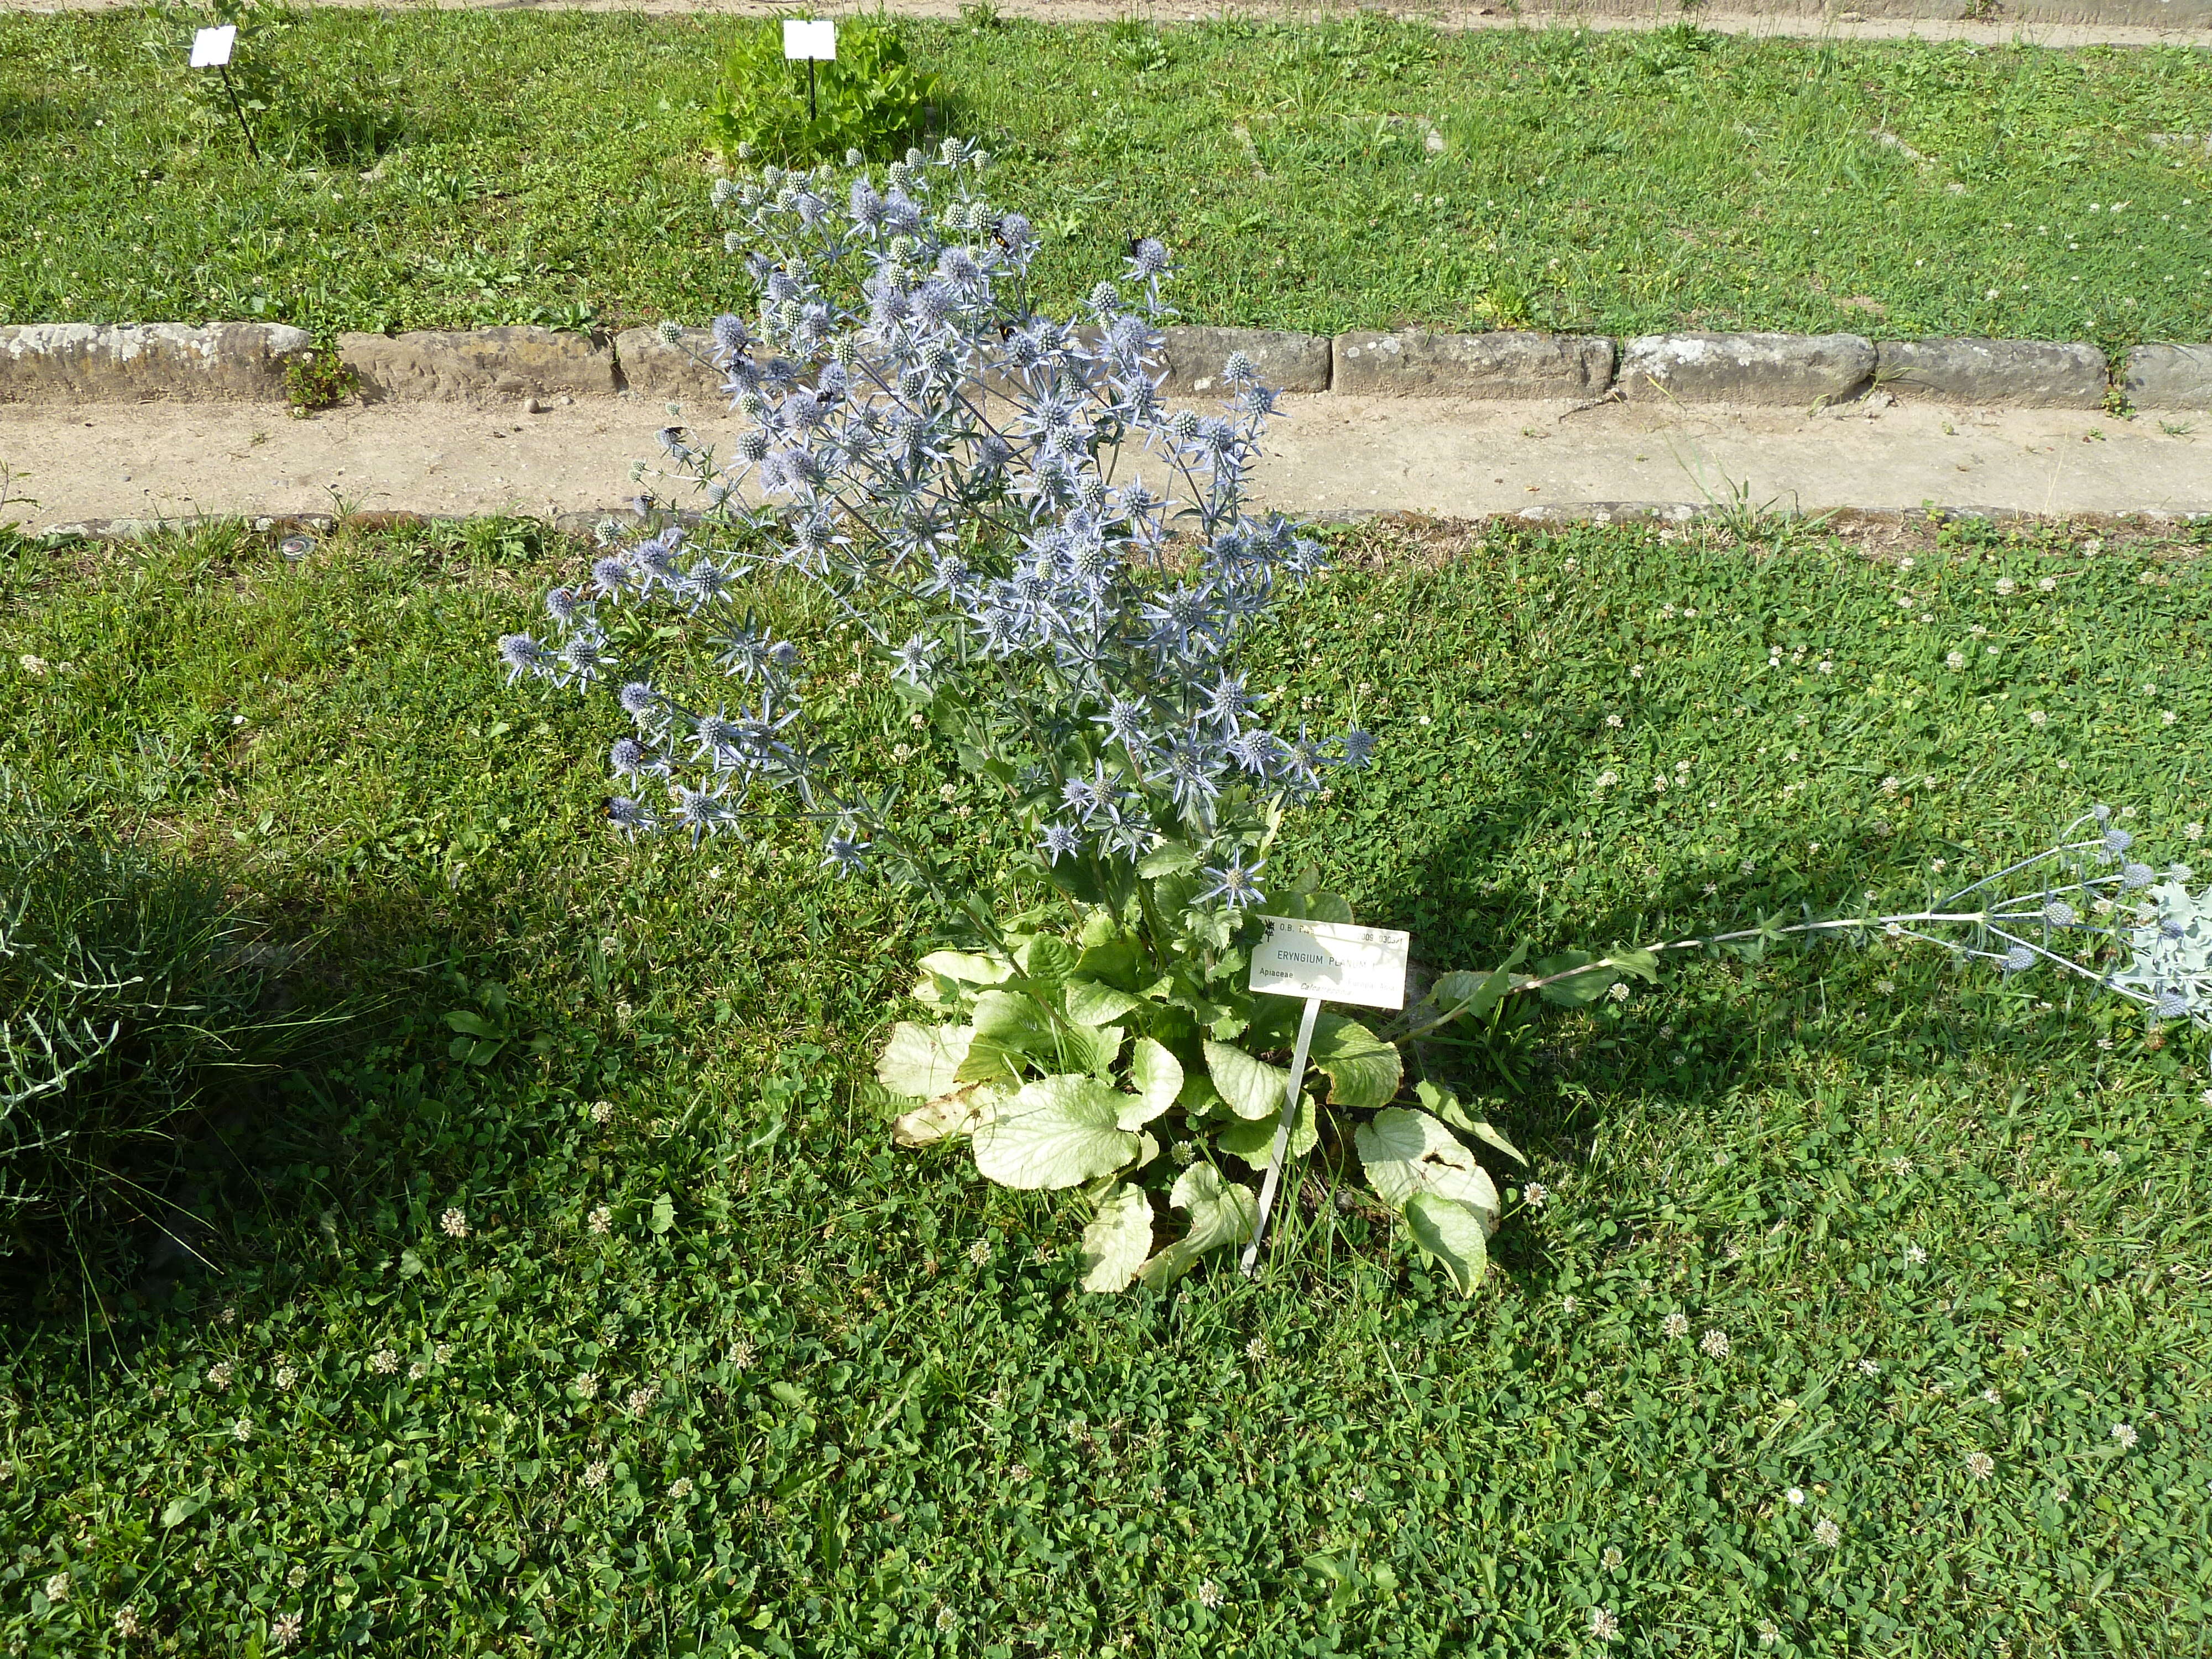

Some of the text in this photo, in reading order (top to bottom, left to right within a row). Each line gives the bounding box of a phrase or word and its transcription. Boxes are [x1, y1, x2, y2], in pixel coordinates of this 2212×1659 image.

[1280, 923, 1295, 932] O.B.
[1277, 950, 1323, 964] ERYNGIUM
[1259, 967, 1293, 978] Apiaceae
